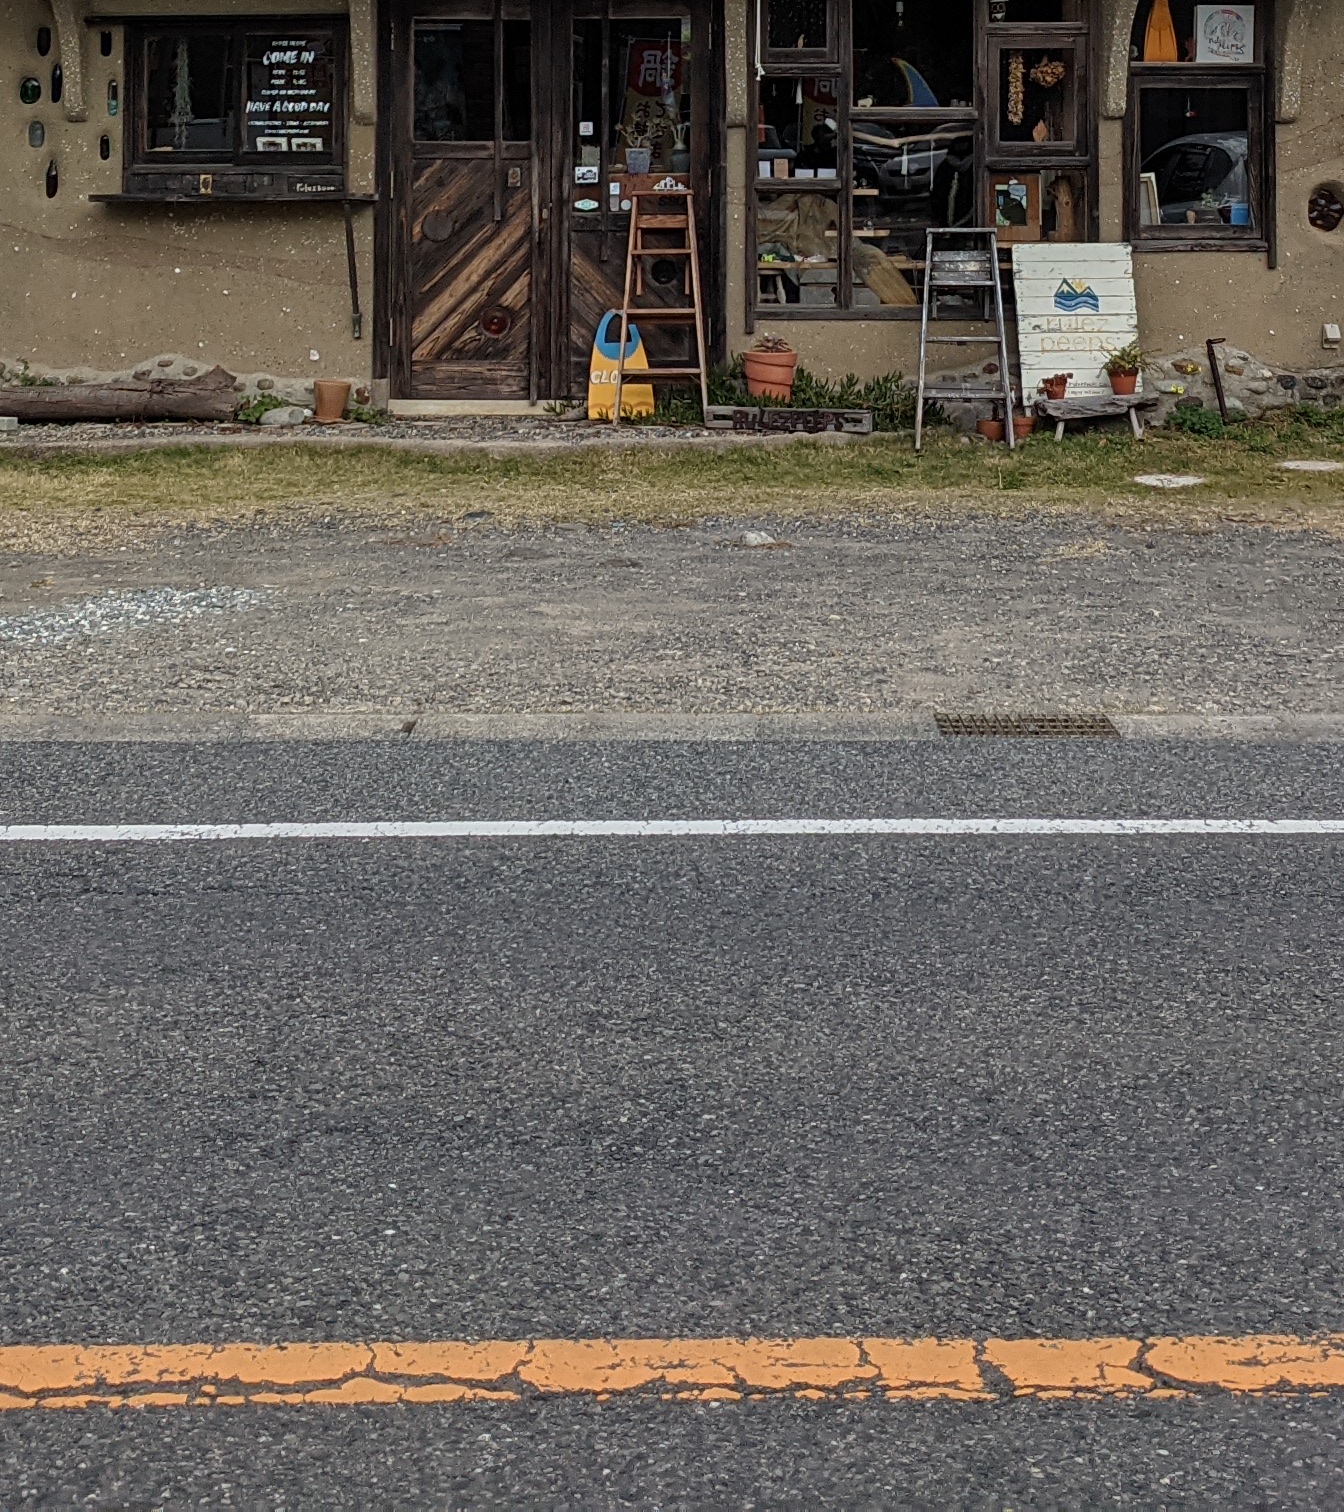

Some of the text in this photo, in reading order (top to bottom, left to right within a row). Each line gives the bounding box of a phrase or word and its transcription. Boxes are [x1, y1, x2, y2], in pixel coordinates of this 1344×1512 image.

[262, 50, 315, 65] COME IN
[245, 100, 272, 113] HAVE
[272, 100, 281, 112] A
[309, 101, 331, 113] DAY
[1046, 317, 1109, 332] rulez
[1040, 335, 1117, 355] peeps
